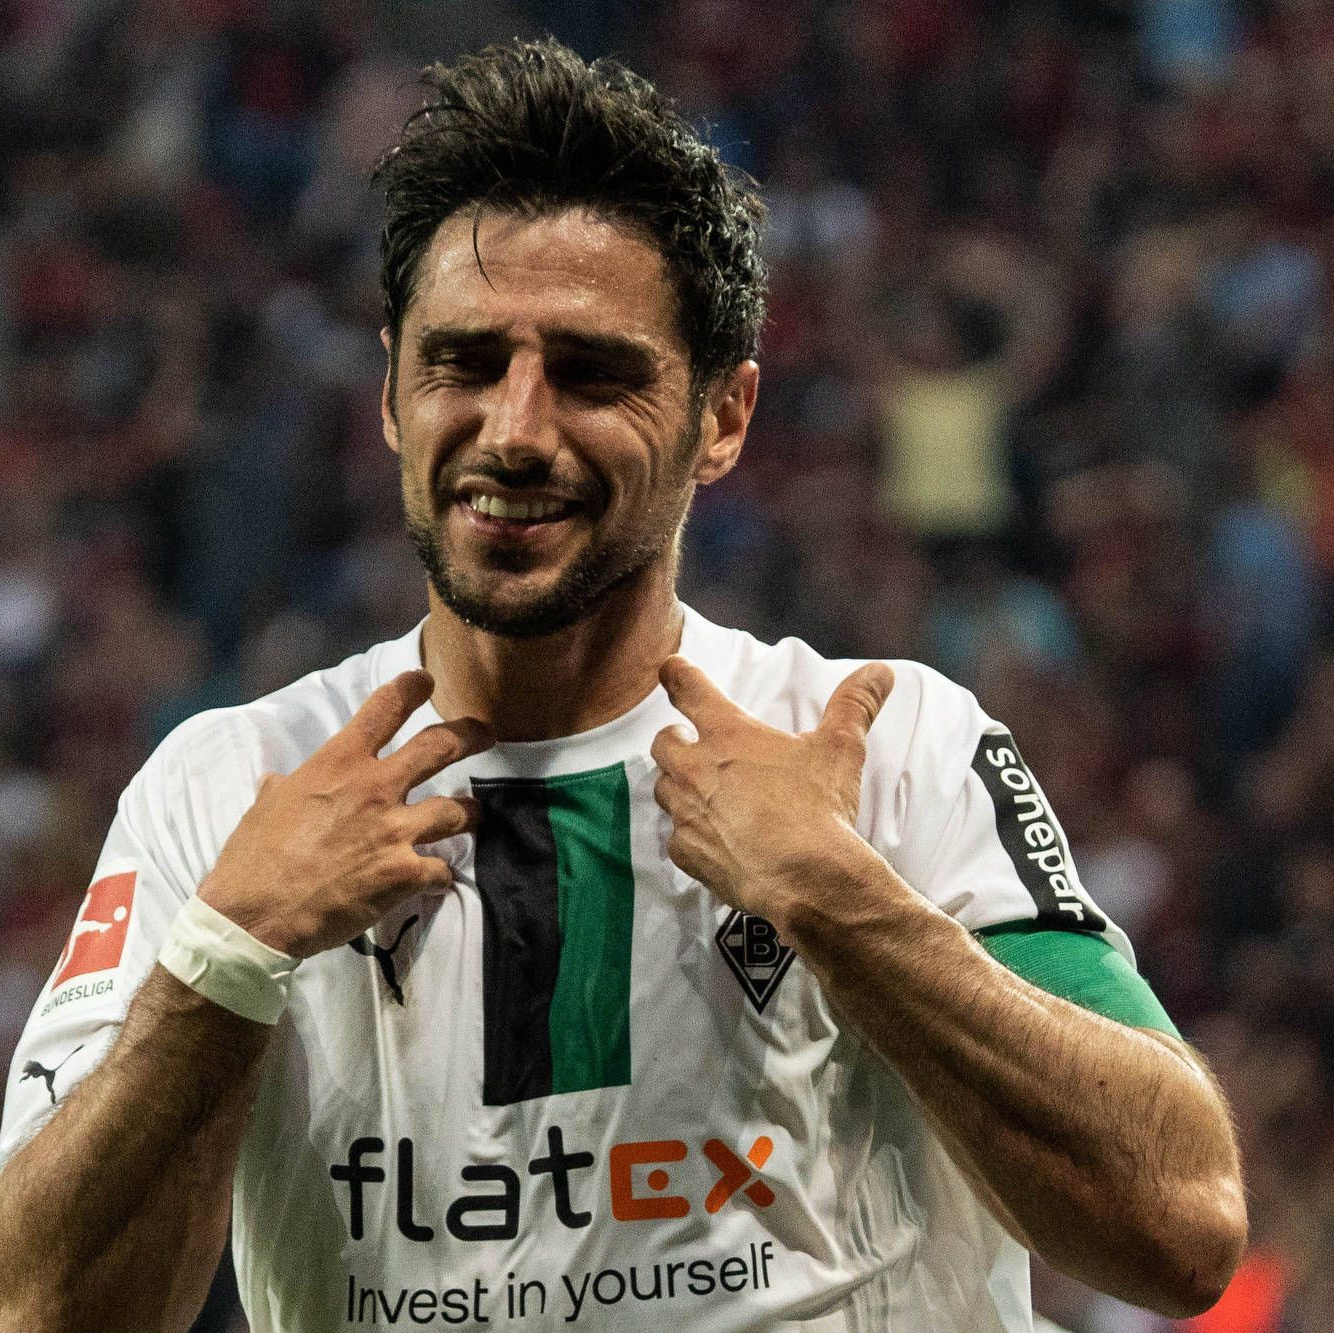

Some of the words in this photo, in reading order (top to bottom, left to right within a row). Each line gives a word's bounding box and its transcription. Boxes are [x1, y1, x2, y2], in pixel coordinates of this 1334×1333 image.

[986, 747, 1085, 921] sonepar
[346, 1274, 489, 1325] Invest
[507, 1271, 547, 1320] in
[562, 1241, 775, 1322] yourself
